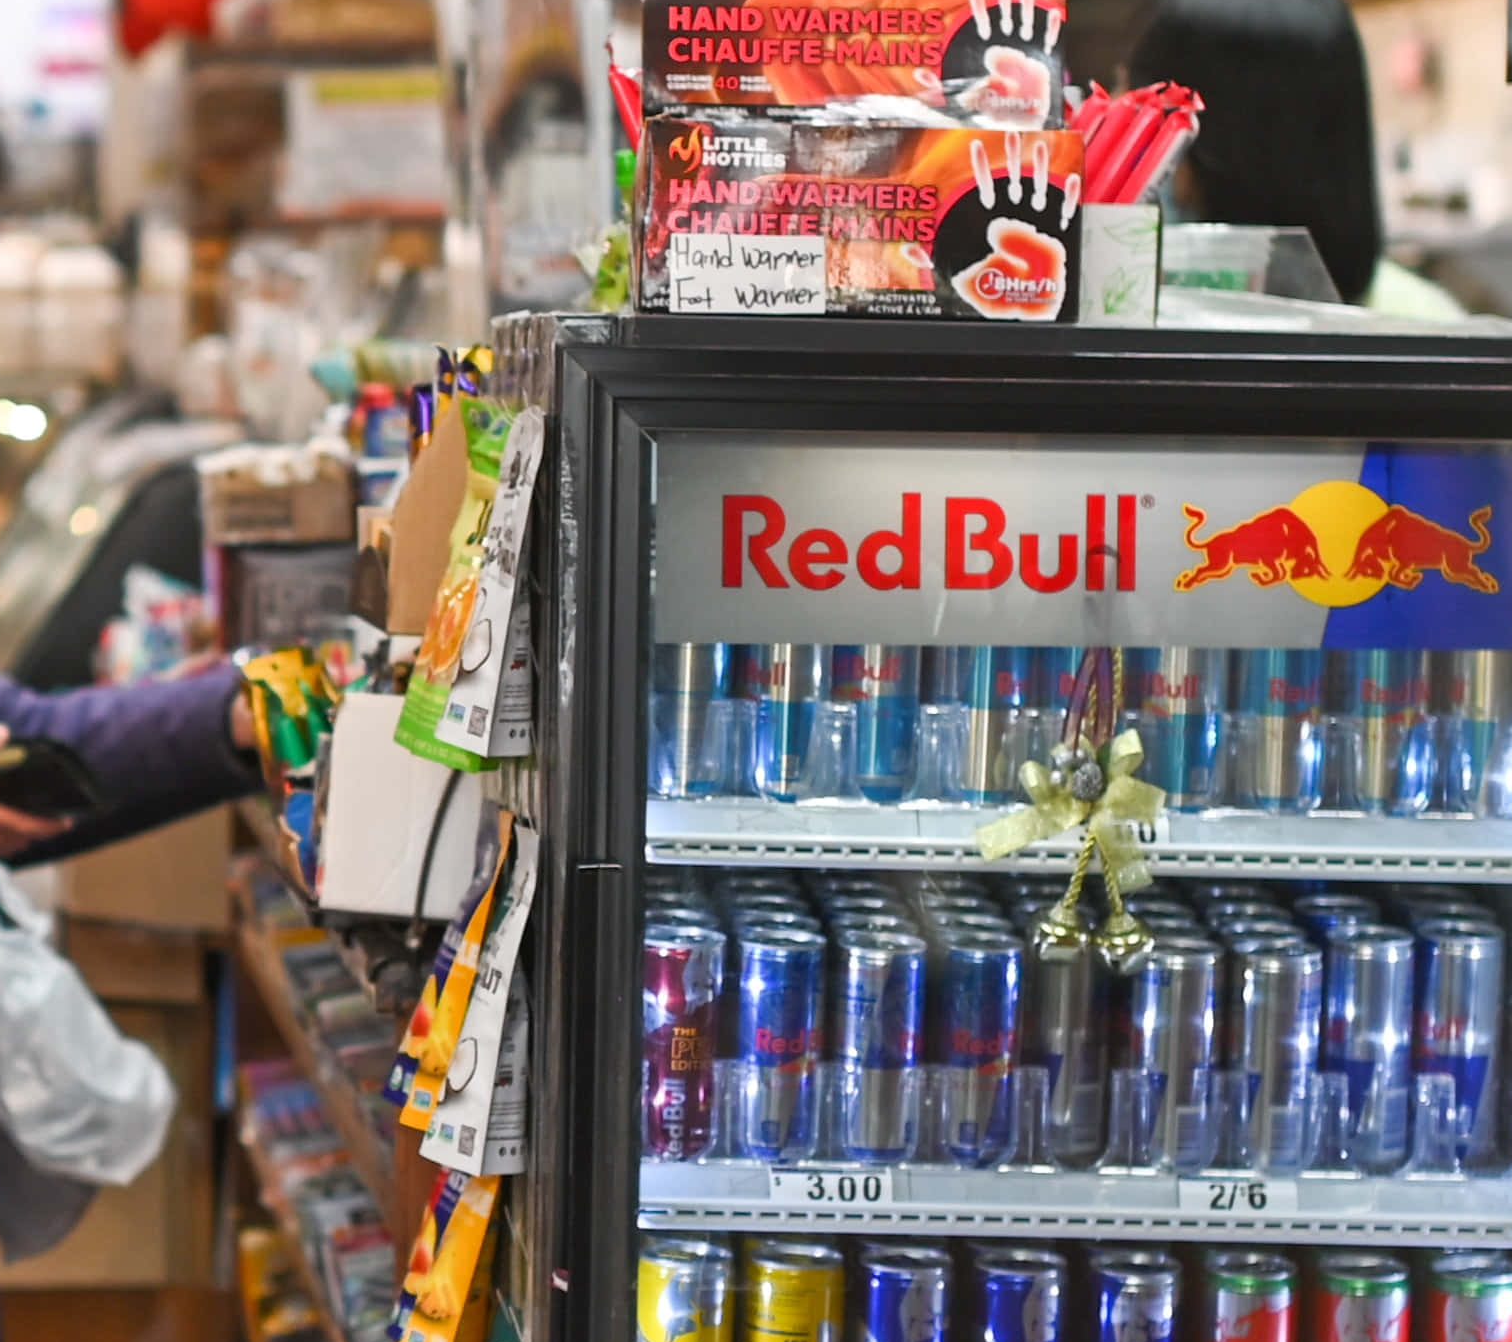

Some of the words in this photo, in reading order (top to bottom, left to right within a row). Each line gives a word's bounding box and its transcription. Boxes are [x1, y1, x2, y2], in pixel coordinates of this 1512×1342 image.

[667, 5, 765, 33] HAND
[772, 8, 944, 35] WARMERS
[667, 37, 943, 67] CHAUFFE-MAINS
[714, 75, 739, 91] 40
[702, 136, 768, 153] LITTLE
[702, 152, 786, 169] HOTTIES
[667, 179, 763, 206] HAND
[772, 181, 938, 210] WARMERS
[666, 211, 937, 243] CHAUFFE-MAINS
[674, 233, 733, 270] Hand
[675, 278, 714, 306] Foot
[720, 492, 922, 591] Red
[943, 492, 1138, 593] Bull
[754, 1028, 806, 1055] Red
[952, 1028, 1004, 1056] Red
[806, 1174, 883, 1203] 3.00
